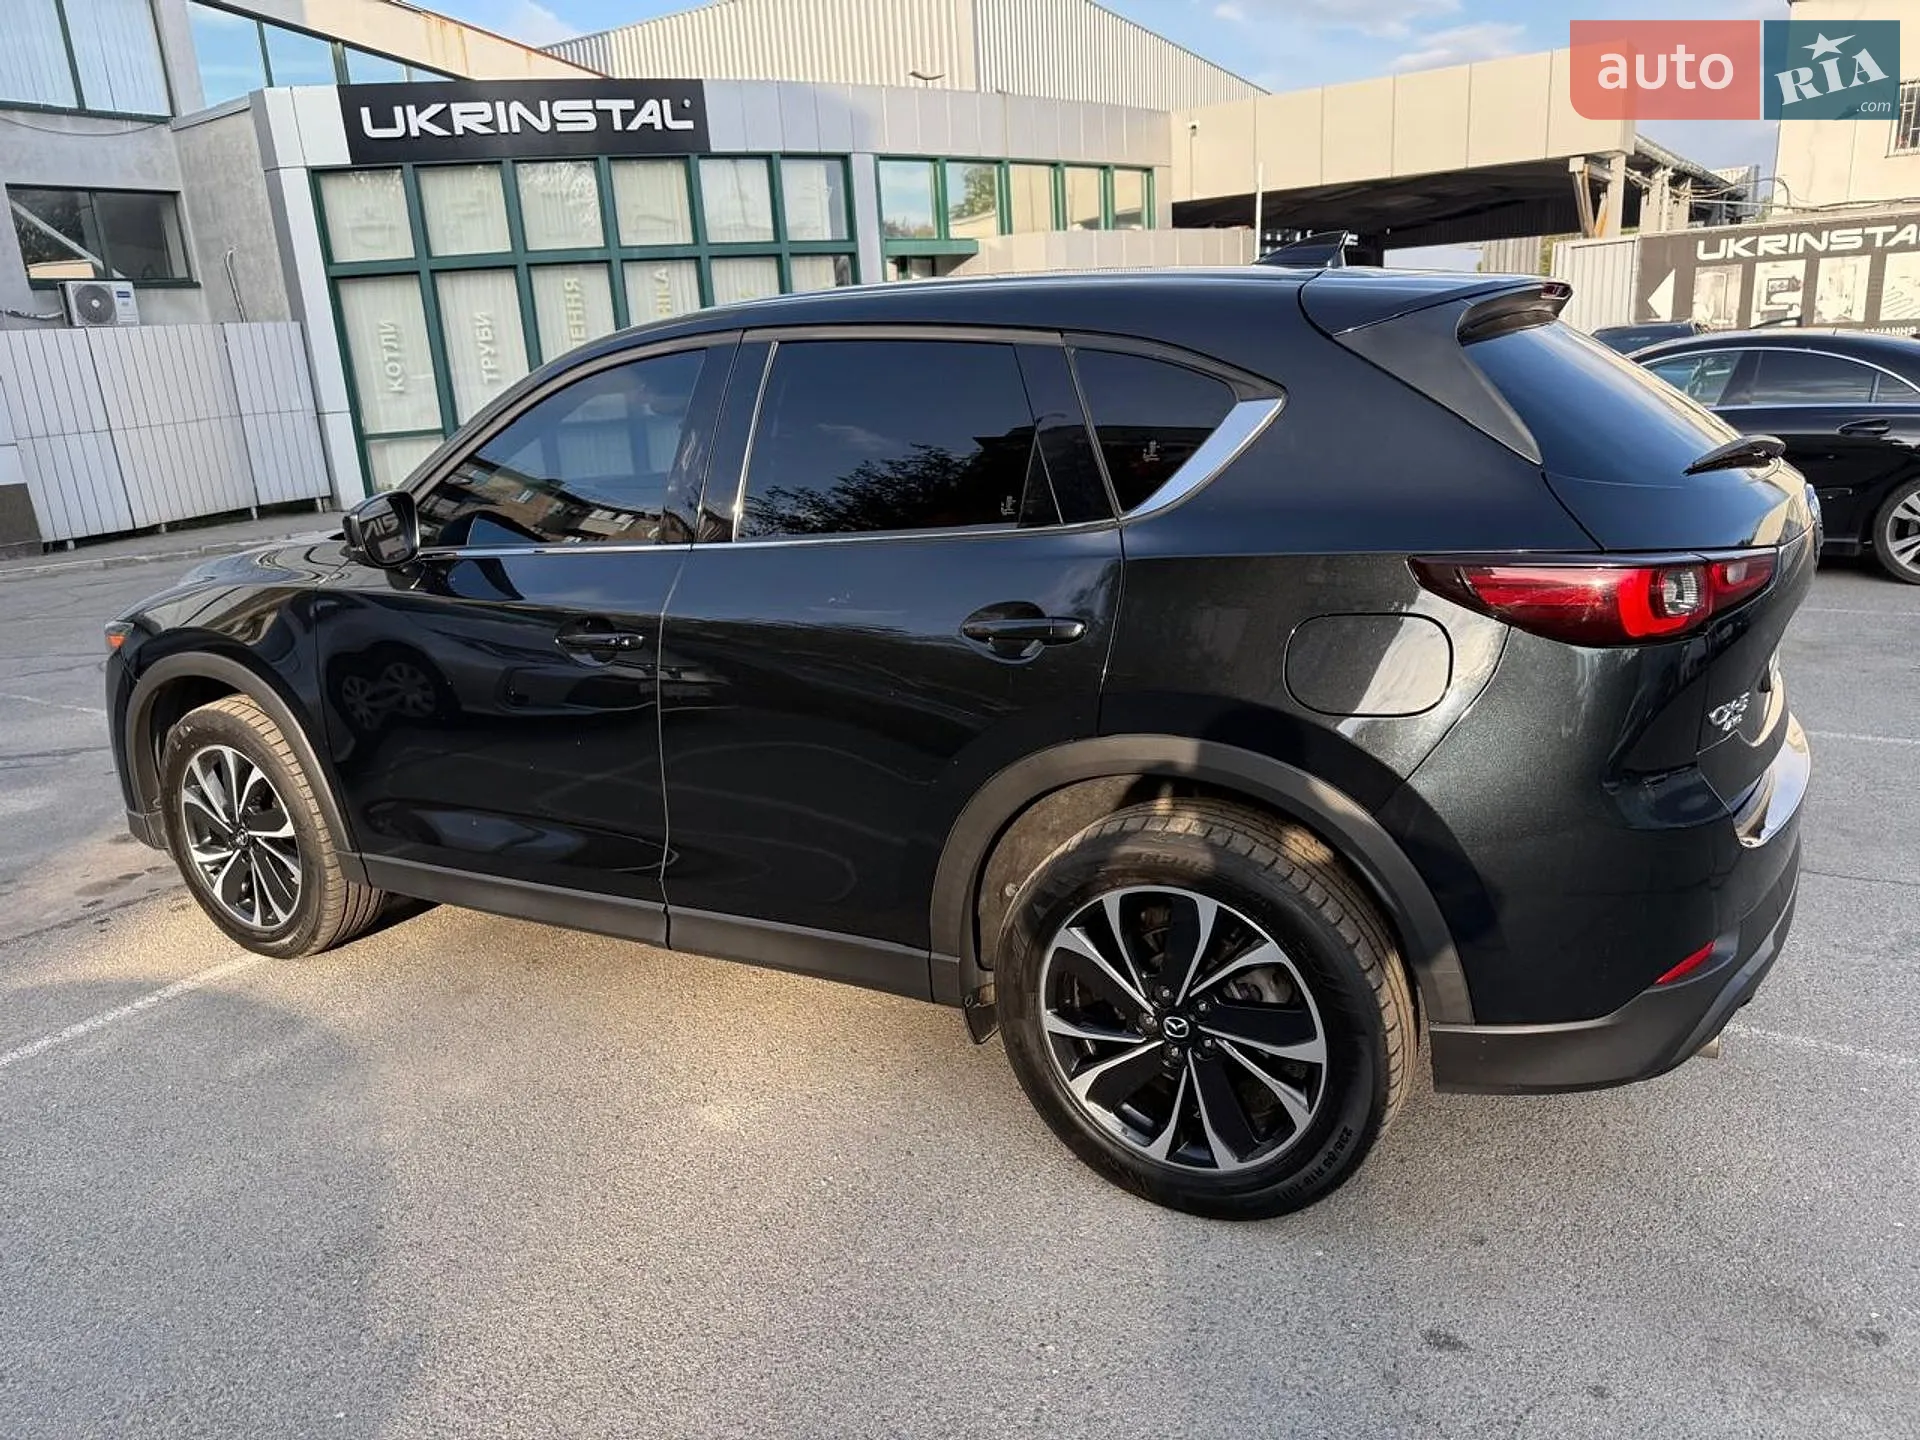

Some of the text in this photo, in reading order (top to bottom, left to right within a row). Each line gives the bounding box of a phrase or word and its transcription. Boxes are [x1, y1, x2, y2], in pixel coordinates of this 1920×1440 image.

[1696, 223, 1920, 261] UKRINSTA
[473, 311, 500, 385] ТРУБИ
[564, 278, 587, 347] ЕННЯ
[379, 320, 405, 394] КОТЛИ
